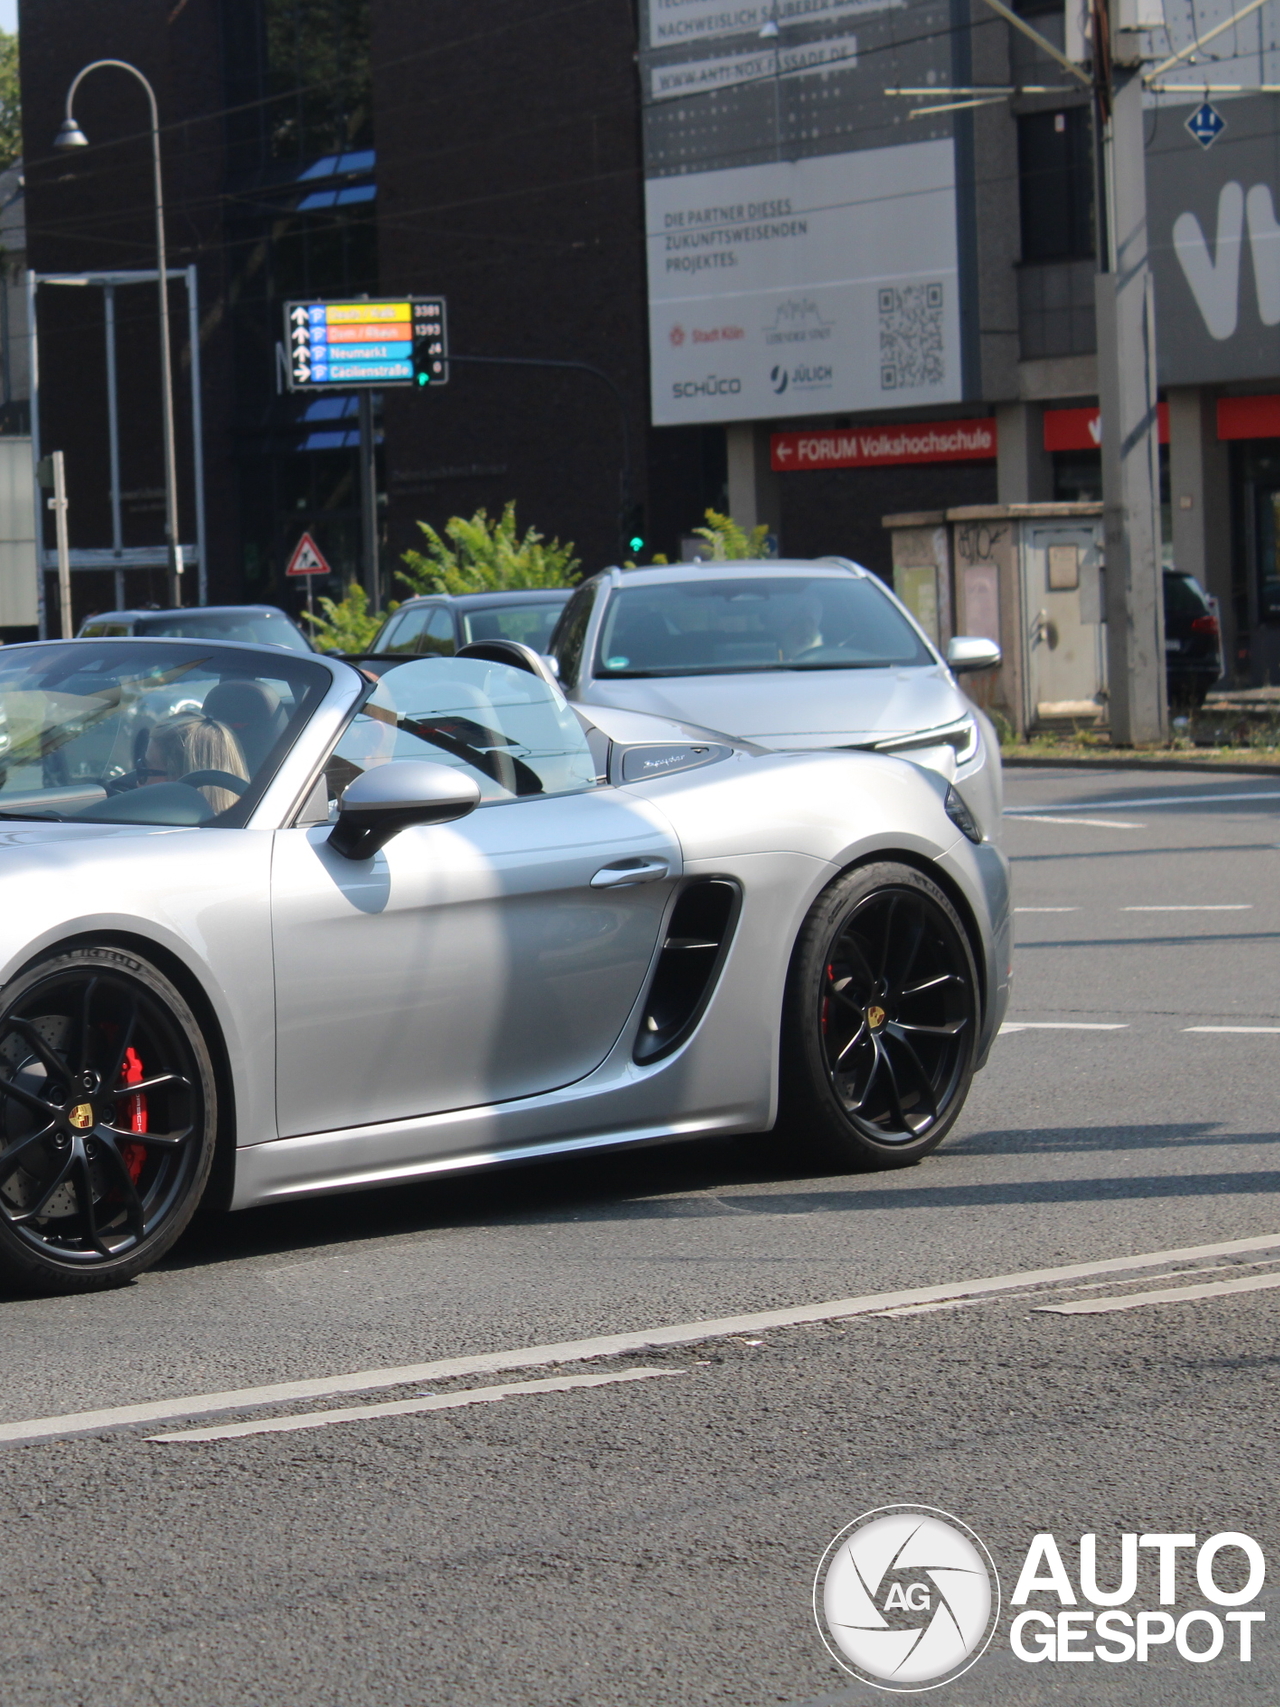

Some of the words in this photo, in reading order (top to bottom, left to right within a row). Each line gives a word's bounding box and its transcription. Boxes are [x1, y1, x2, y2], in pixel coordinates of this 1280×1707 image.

[658, 8, 756, 37] NACHWEISLICH
[664, 212, 684, 228] DIE
[688, 204, 744, 224] PARTNER
[748, 199, 792, 218] DIESES
[665, 220, 807, 250] ZUKUNFTSWEISENDEN
[331, 347, 387, 359] Neumarkt
[331, 364, 409, 377] Cäcilienstraße
[792, 363, 833, 382] JÜLICH
[672, 374, 741, 398] SCHÜCO
[798, 437, 857, 461] FORUM
[860, 428, 991, 458] Volkshochschule
